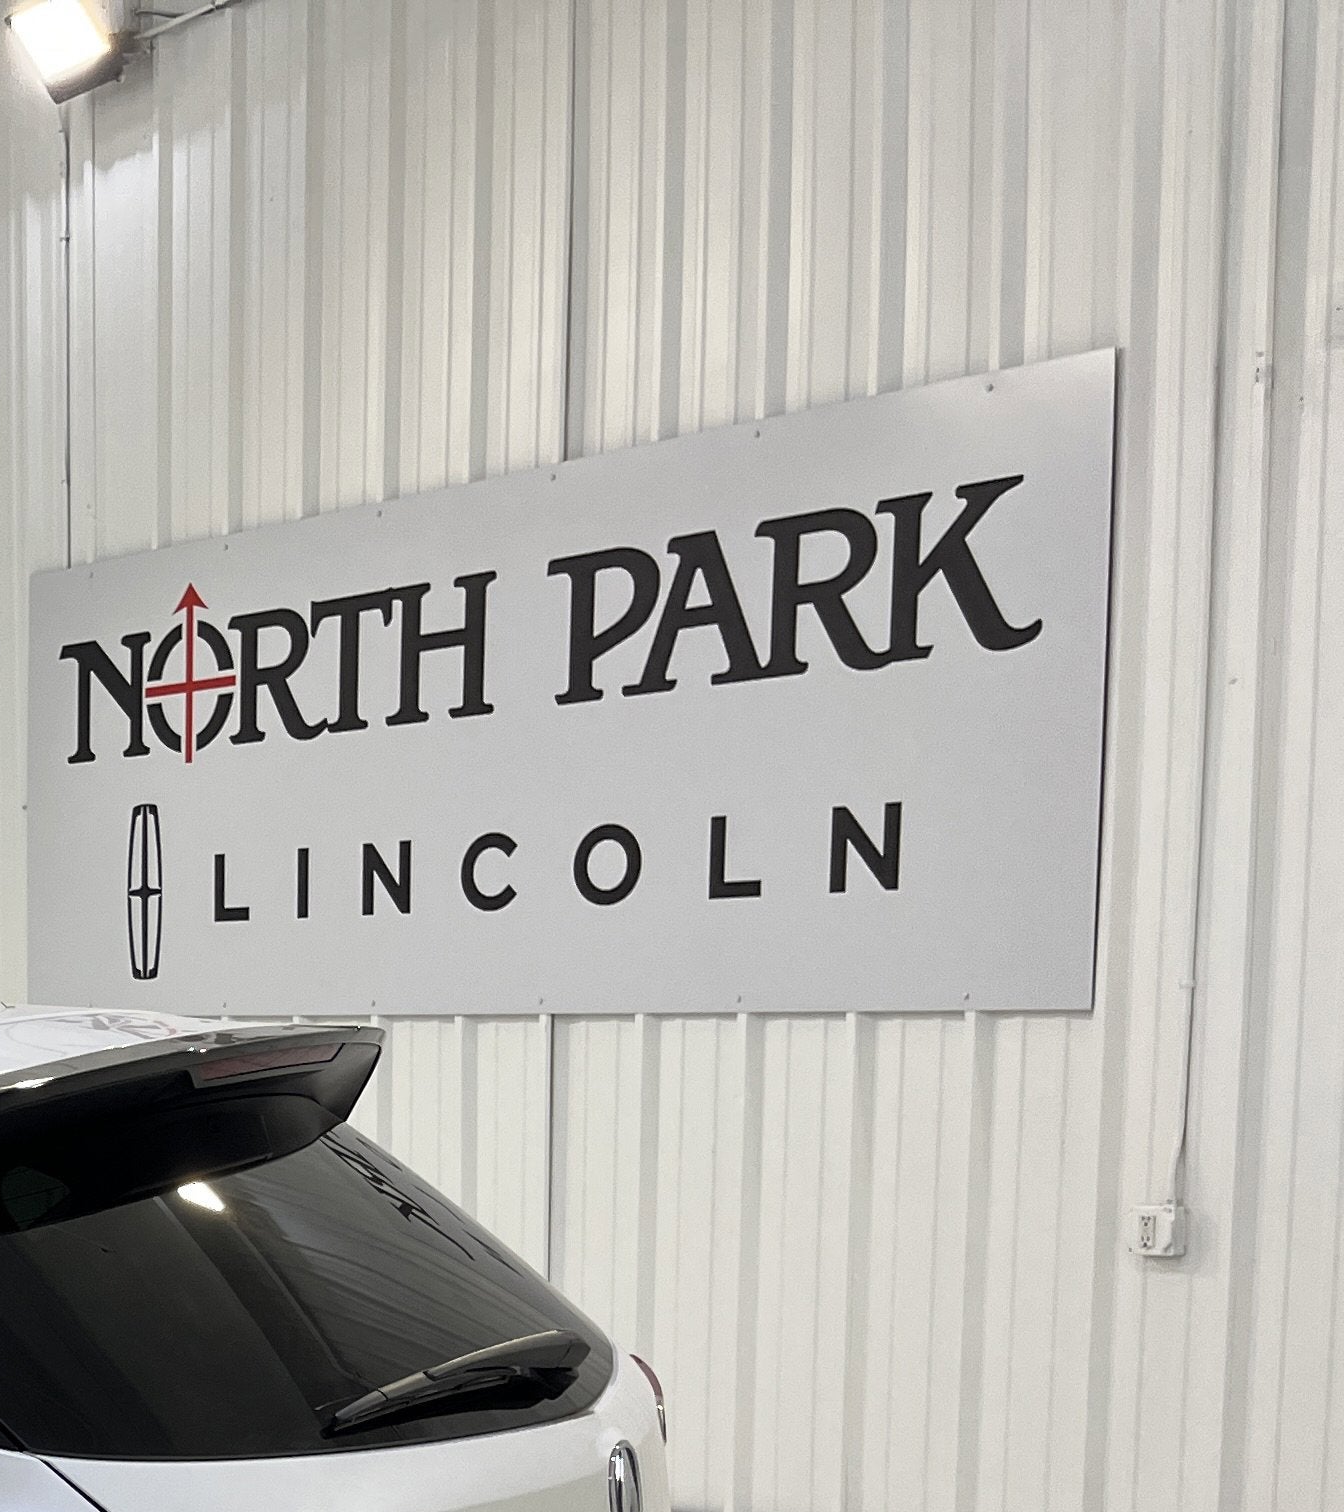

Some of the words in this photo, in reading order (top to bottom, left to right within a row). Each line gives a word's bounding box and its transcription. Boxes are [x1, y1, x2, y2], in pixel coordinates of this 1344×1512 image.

[60, 571, 497, 764] NORTH
[547, 474, 1044, 705] PARK
[213, 801, 903, 922] LINCOLN
